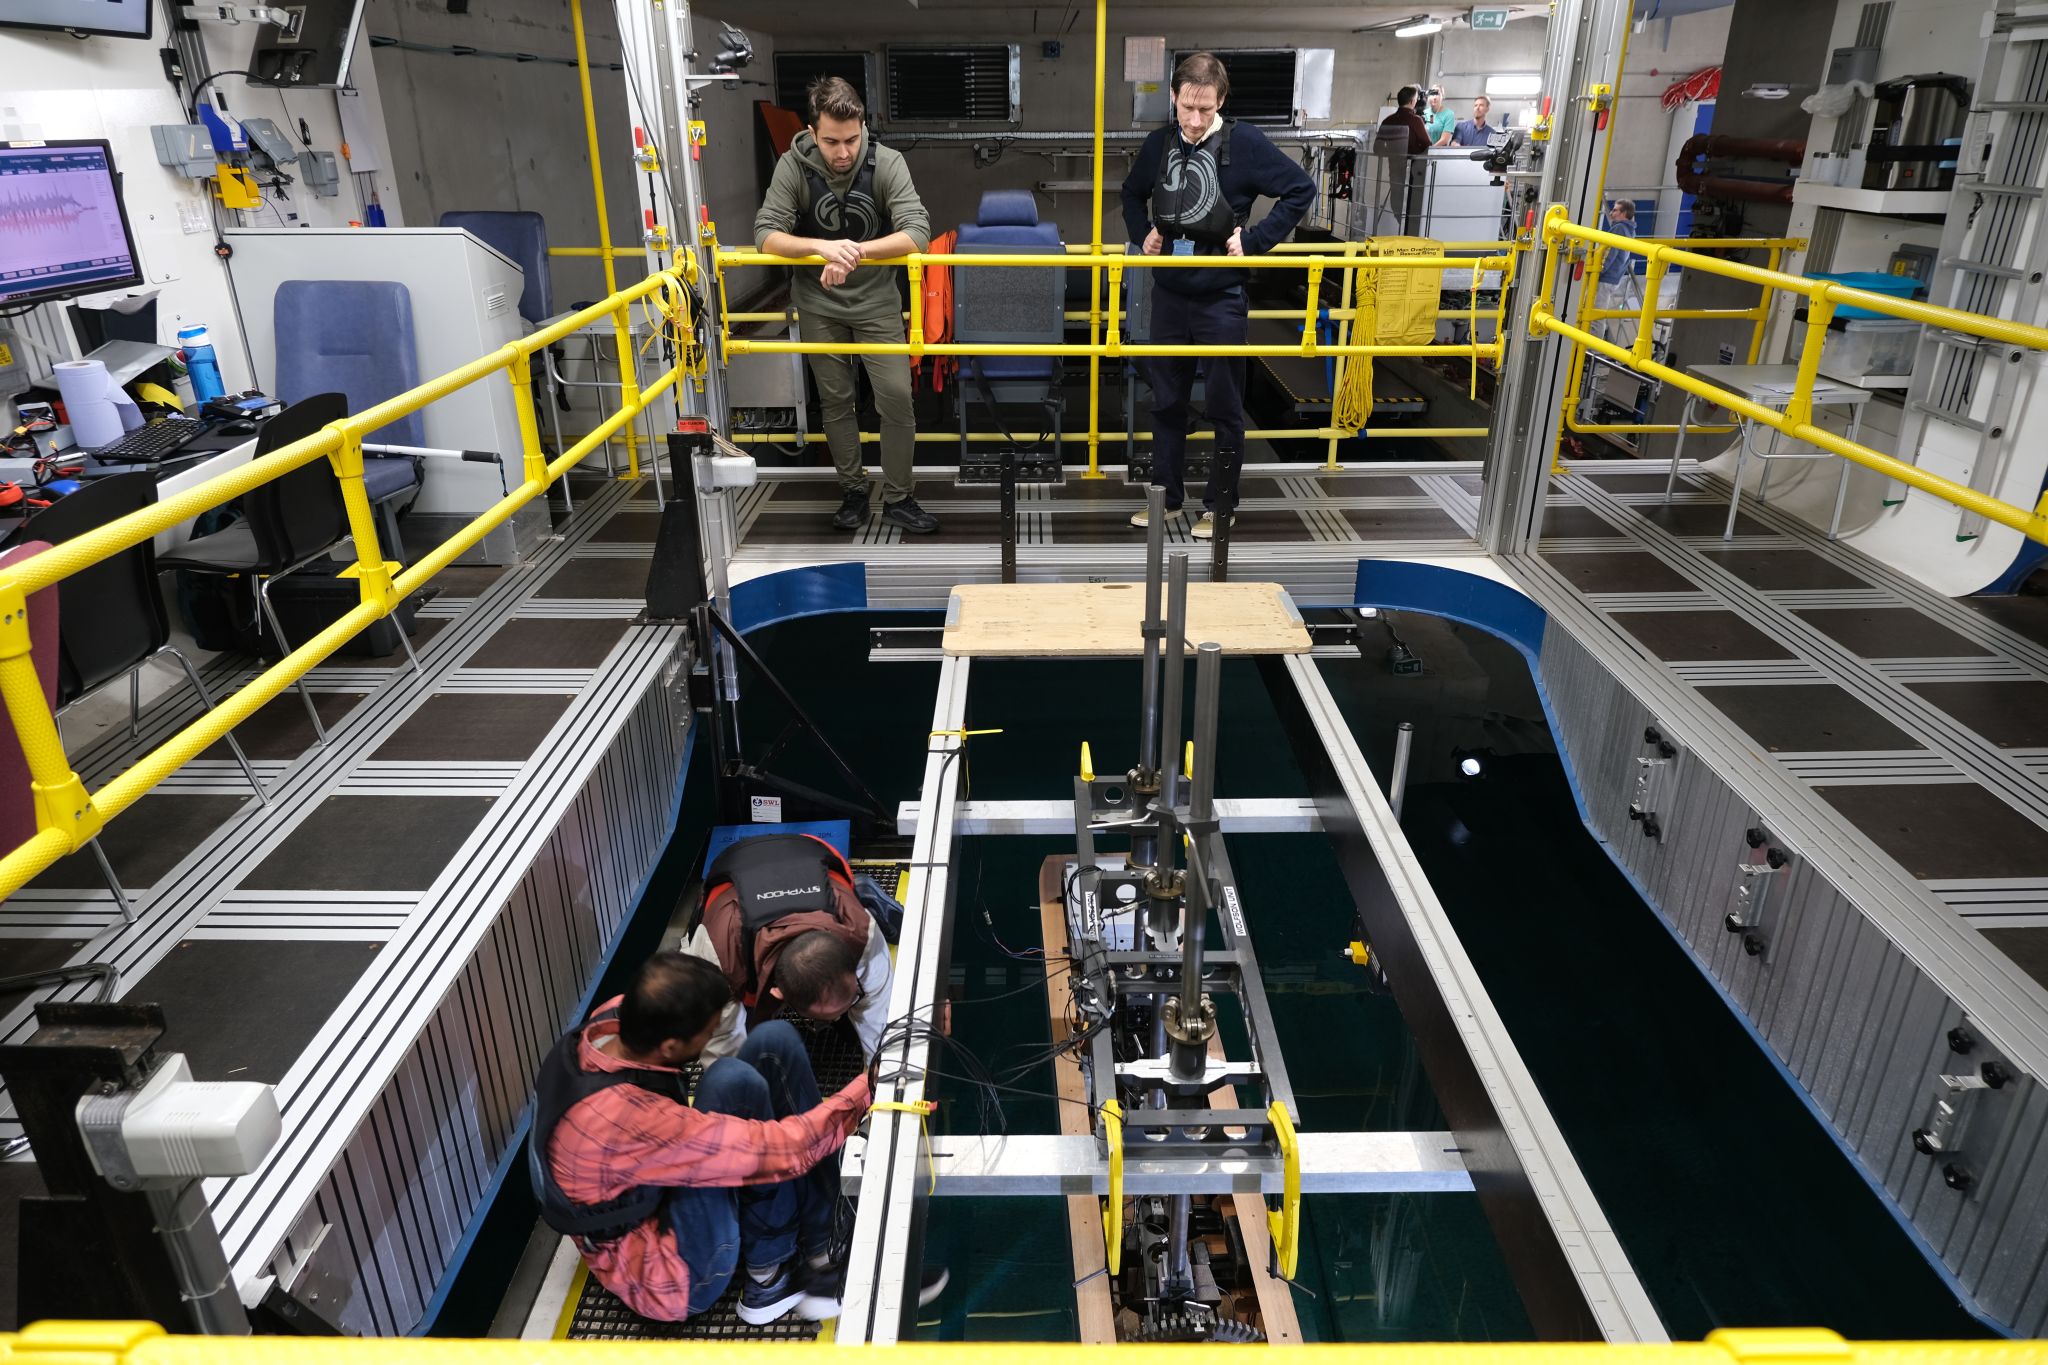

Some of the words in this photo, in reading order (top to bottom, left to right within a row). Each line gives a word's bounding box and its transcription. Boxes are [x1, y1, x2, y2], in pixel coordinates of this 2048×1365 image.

[756, 885, 821, 901] TYPHOON
[1225, 887, 1236, 902] UNIT
[1229, 903, 1245, 935] WOLFSON
